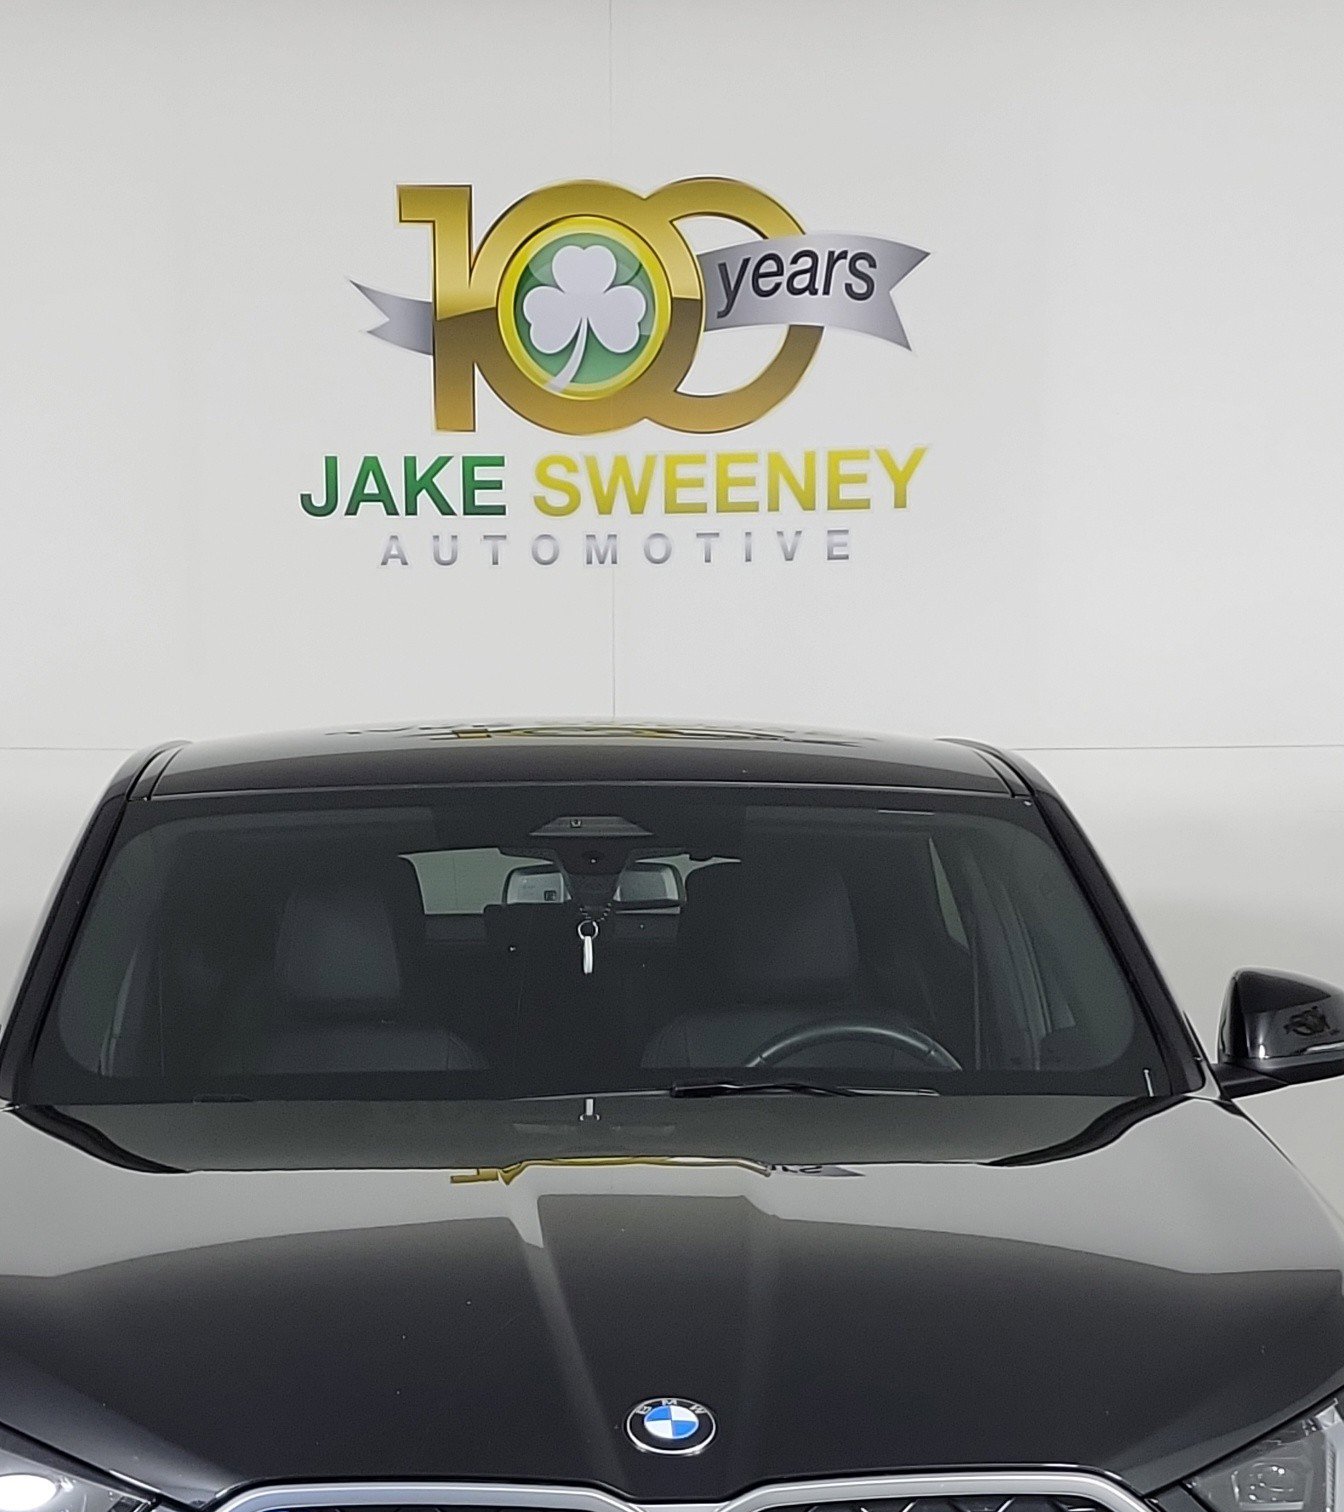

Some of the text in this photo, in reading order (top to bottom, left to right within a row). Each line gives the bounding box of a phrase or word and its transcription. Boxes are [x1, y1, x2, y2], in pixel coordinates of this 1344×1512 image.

[395, 177, 878, 436] 100 years
[299, 446, 929, 517] JAKE SWEENEY
[380, 529, 851, 567] AUTOMOTIVE
